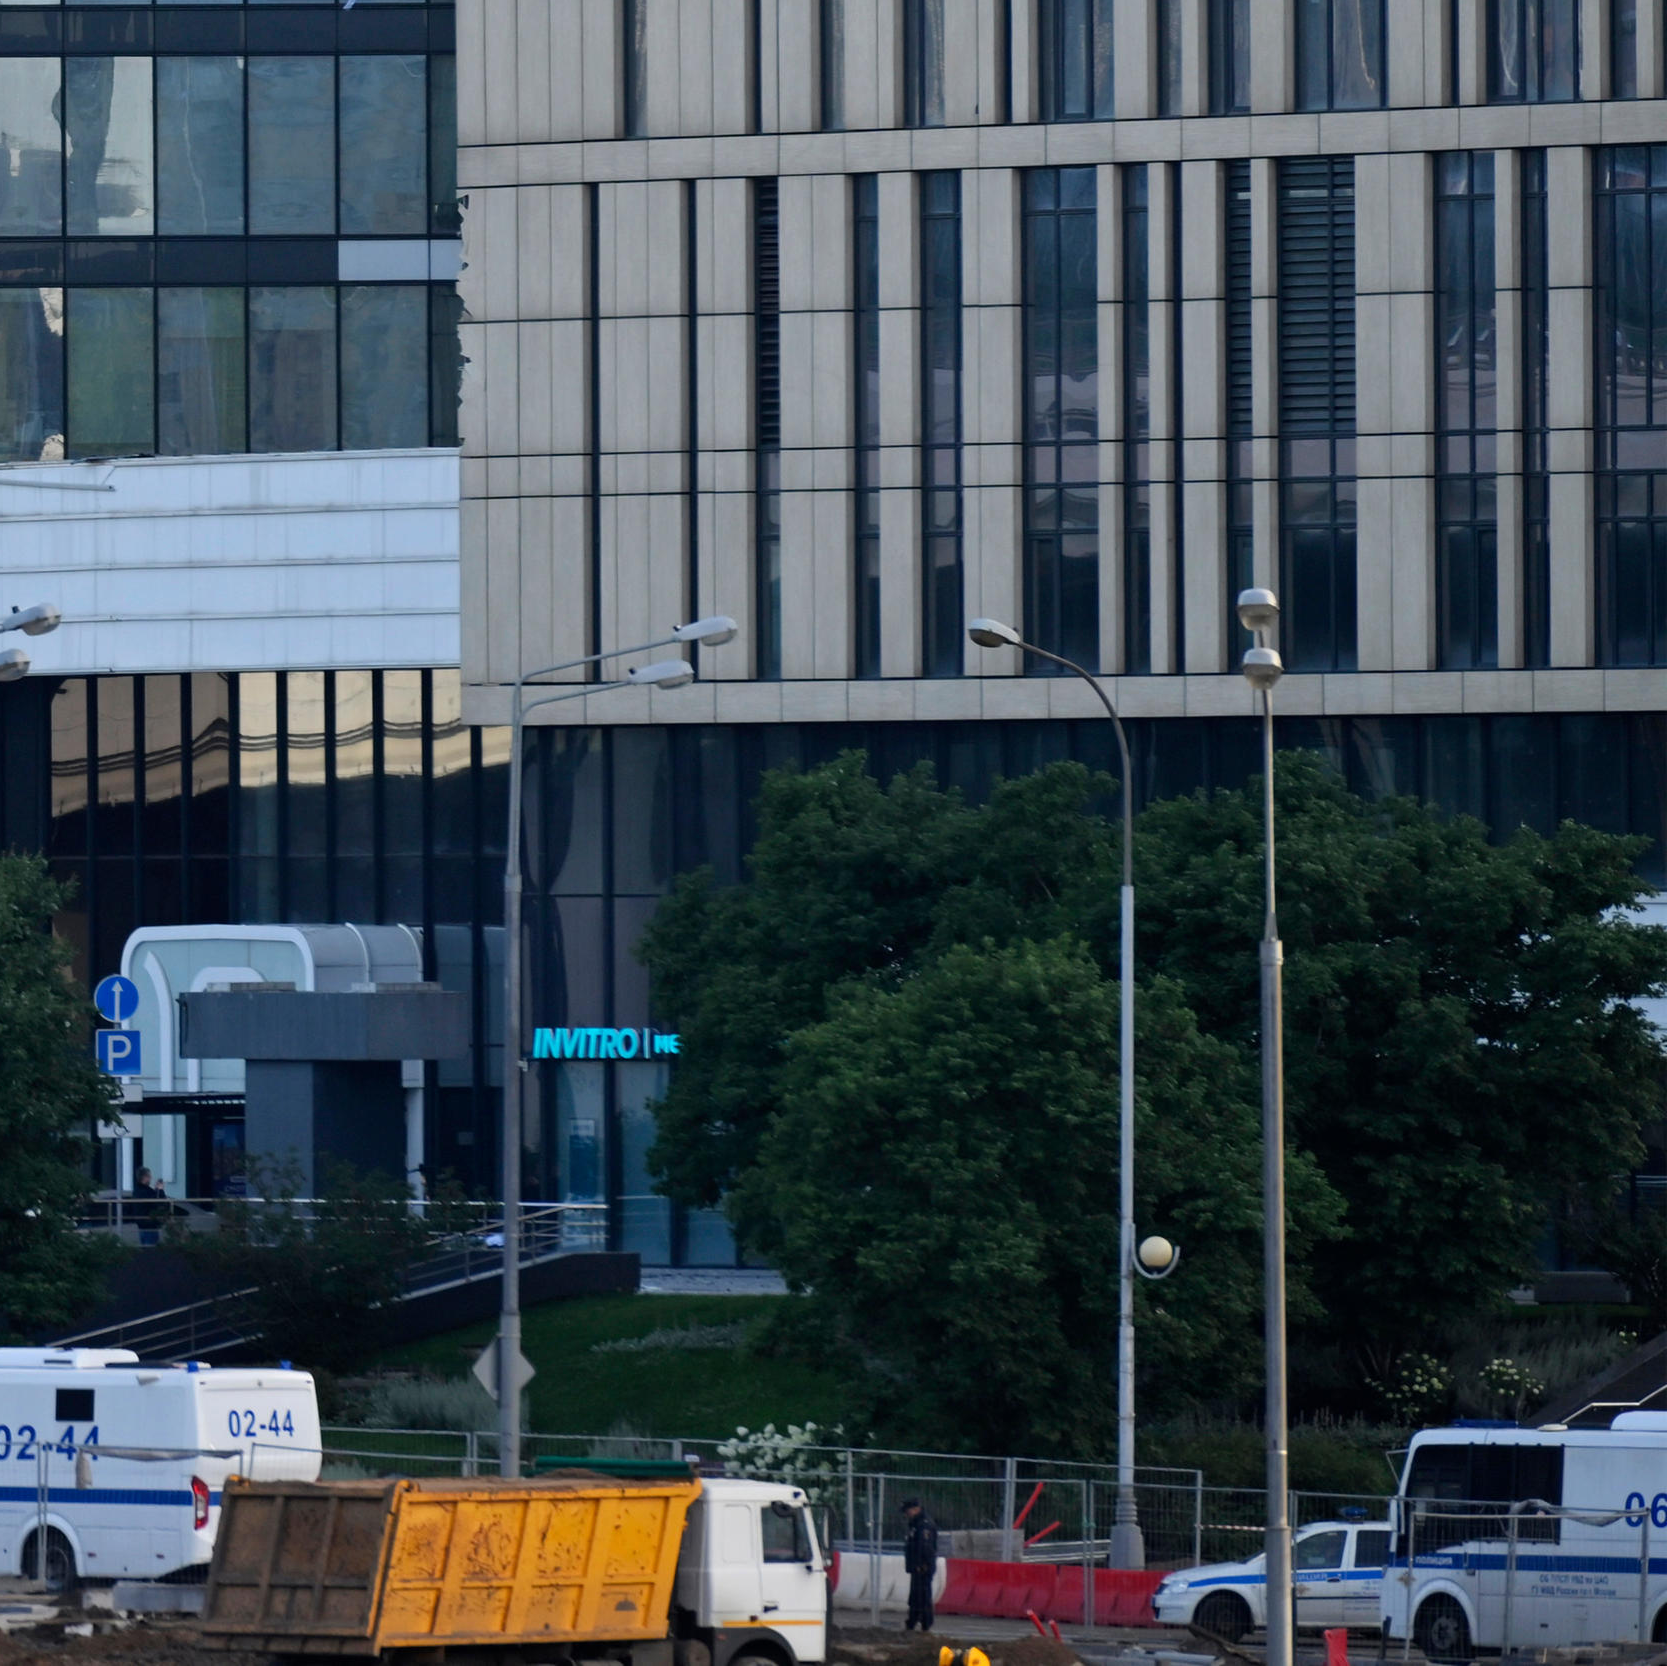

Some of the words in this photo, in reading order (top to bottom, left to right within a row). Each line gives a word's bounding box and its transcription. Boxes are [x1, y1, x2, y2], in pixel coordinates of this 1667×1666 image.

[107, 1035, 132, 1071] P
[533, 1027, 641, 1060] INVITRO
[228, 1409, 295, 1437] 02-44
